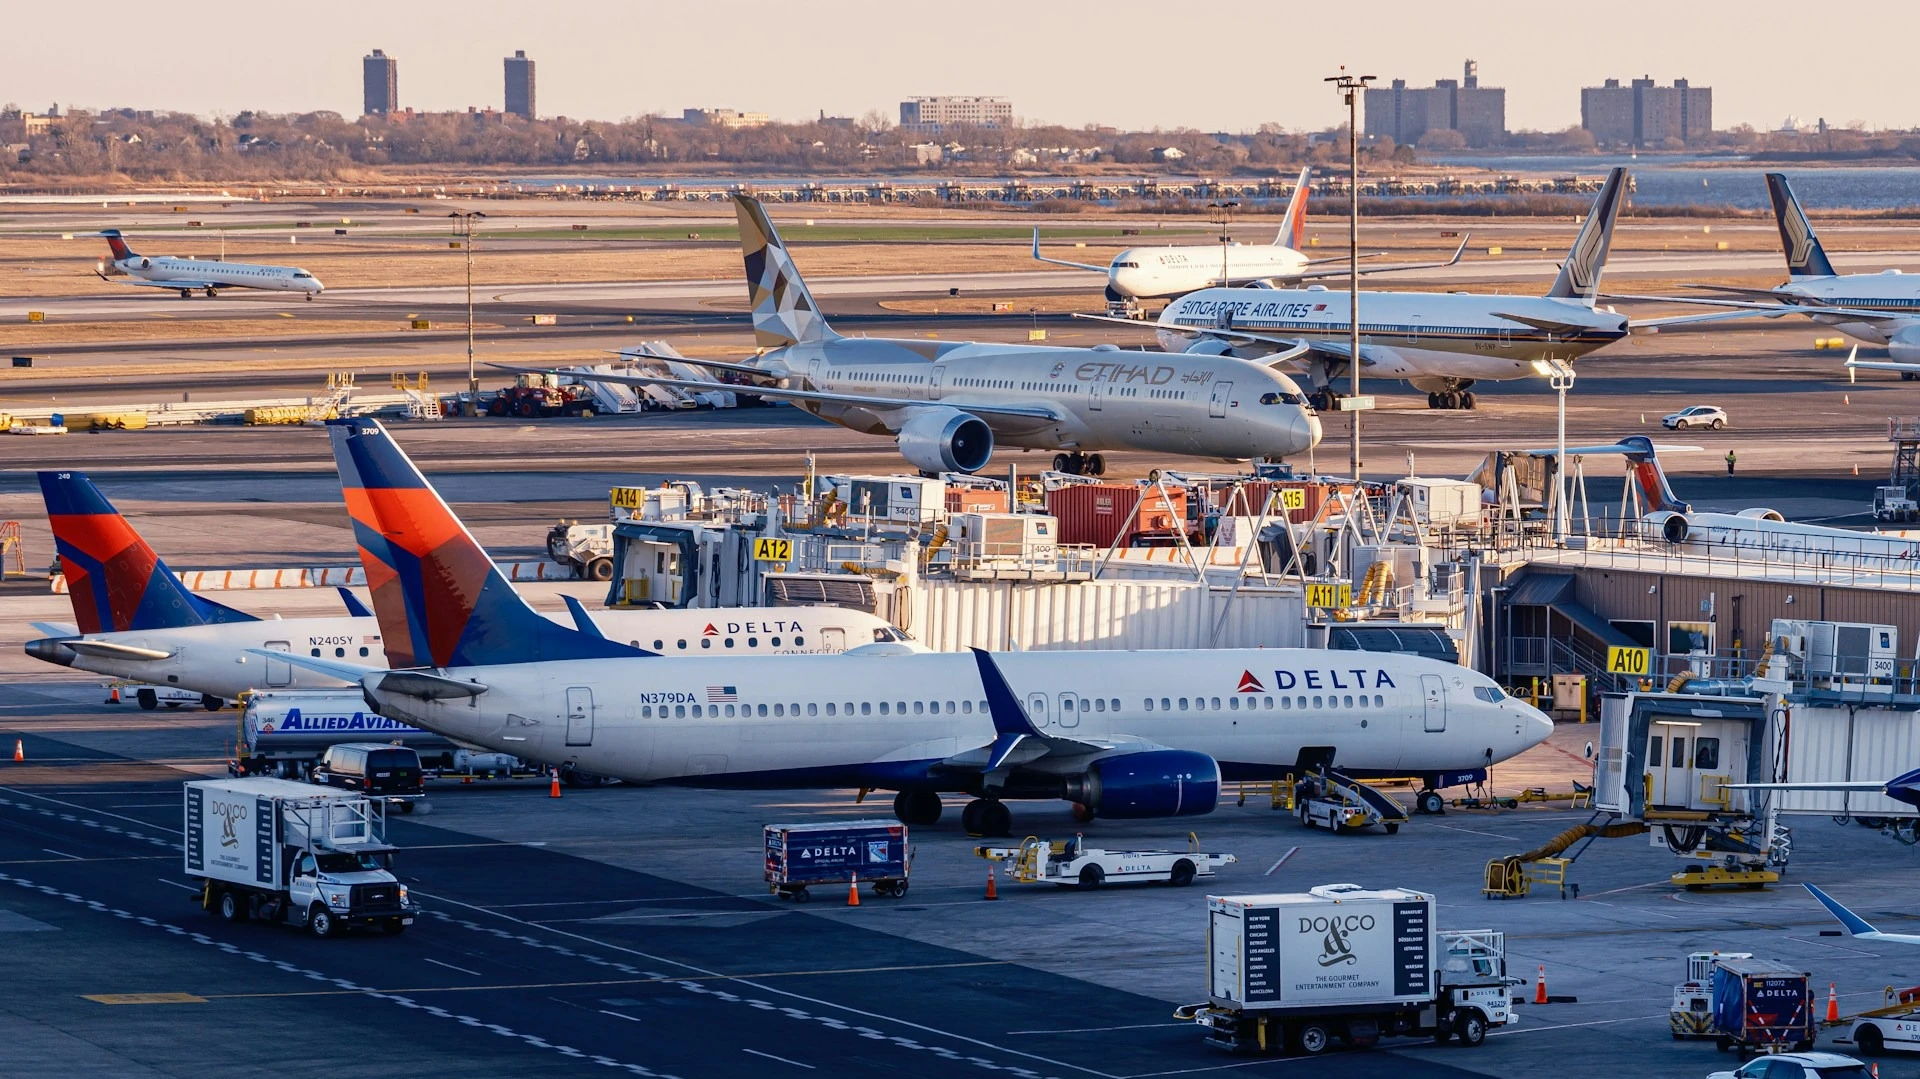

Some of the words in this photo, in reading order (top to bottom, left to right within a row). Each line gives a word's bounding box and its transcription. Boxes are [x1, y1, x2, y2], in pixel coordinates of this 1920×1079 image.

[1166, 255, 1189, 264] DELTA
[1179, 300, 1251, 317] SINGAPORE
[1252, 303, 1312, 318] AIRLINES
[1075, 362, 1175, 385] ETIHAD
[615, 488, 637, 506] A14
[1283, 491, 1301, 507] A15
[758, 540, 789, 559] A12
[1312, 586, 1333, 606] A11
[1340, 586, 1350, 607] A11
[727, 621, 804, 634] DELTA
[309, 636, 354, 646] N240SY
[1613, 648, 1644, 673] A10
[1874, 660, 1892, 671] 3400
[1274, 669, 1397, 690] DELTA
[641, 692, 696, 704] N379DA
[1457, 774, 1474, 783] 3709
[814, 846, 857, 857] DELTA
[1329, 974, 1360, 982] GOURMET
[1295, 982, 1346, 991] ENTERTAINMENT
[1348, 980, 1380, 989] COMPANY
[1766, 989, 1798, 997] DELTA
